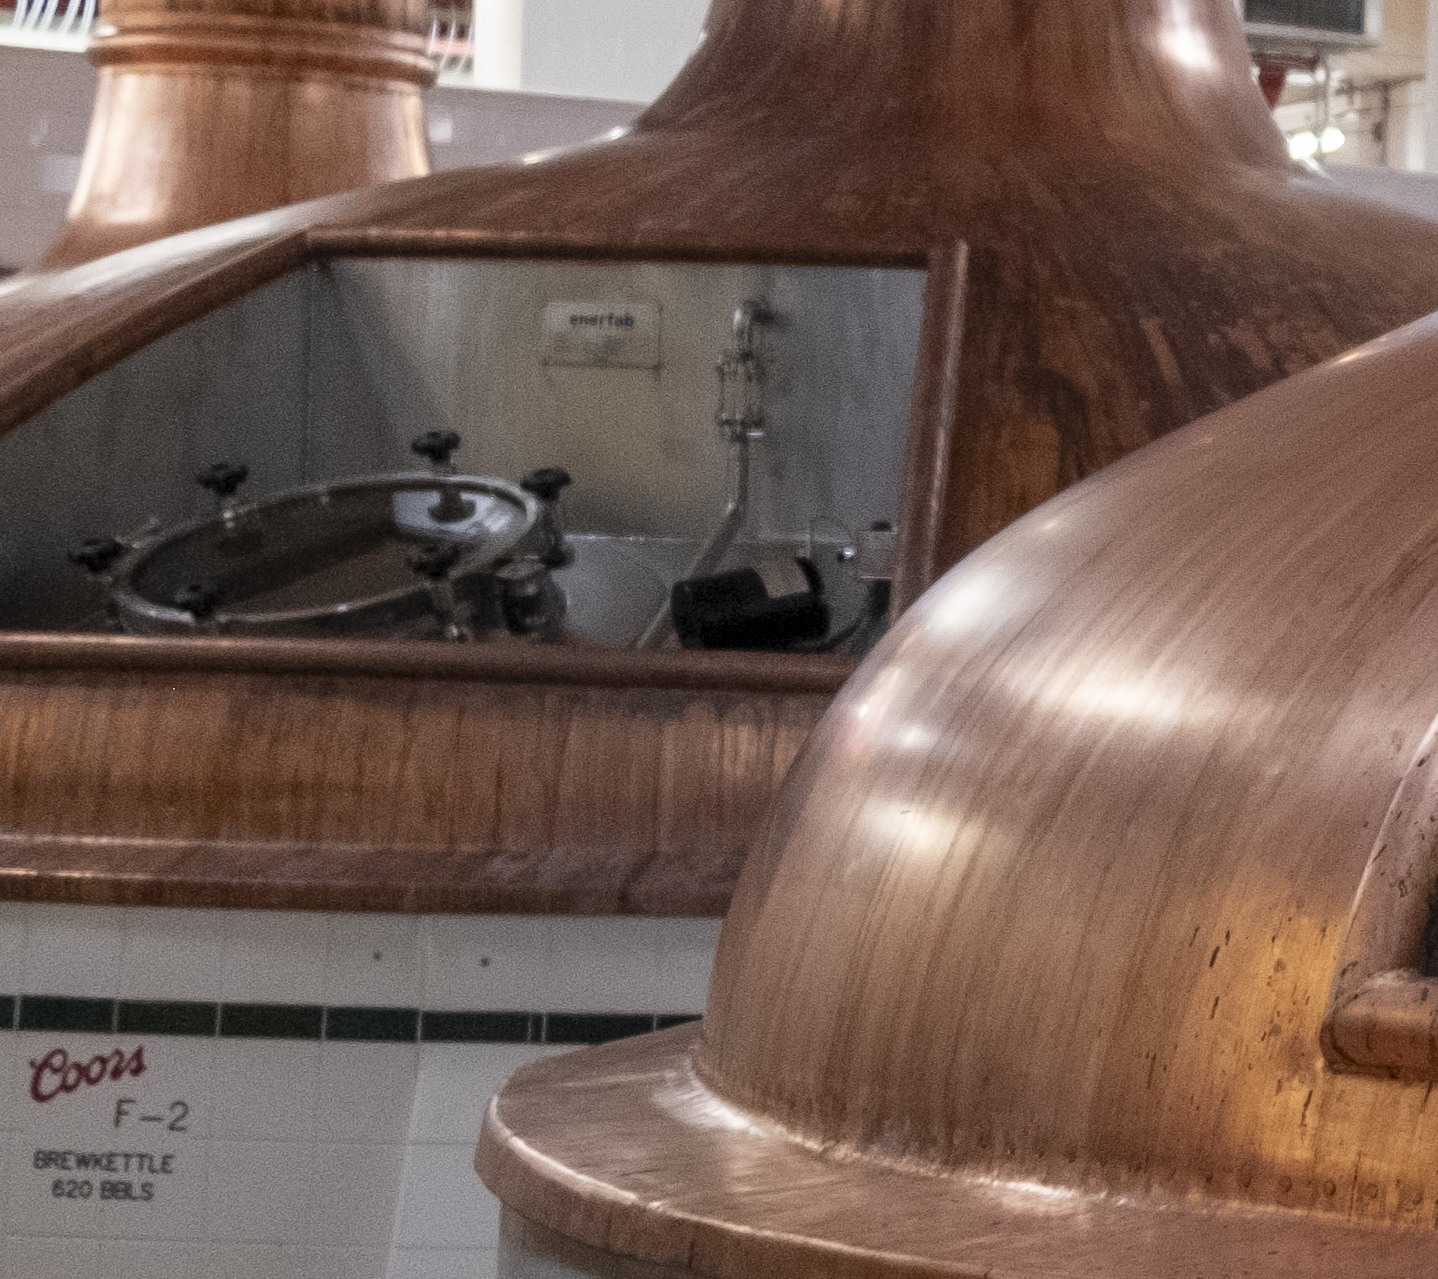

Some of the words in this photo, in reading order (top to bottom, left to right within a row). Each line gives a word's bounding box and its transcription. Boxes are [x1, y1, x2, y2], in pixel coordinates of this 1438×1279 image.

[28, 1044, 148, 1103] Coors
[112, 1097, 190, 1132] F-2
[32, 1148, 175, 1175] BREWKETTLE
[50, 1178, 94, 1199] 620
[99, 1179, 156, 1201] BBLS
